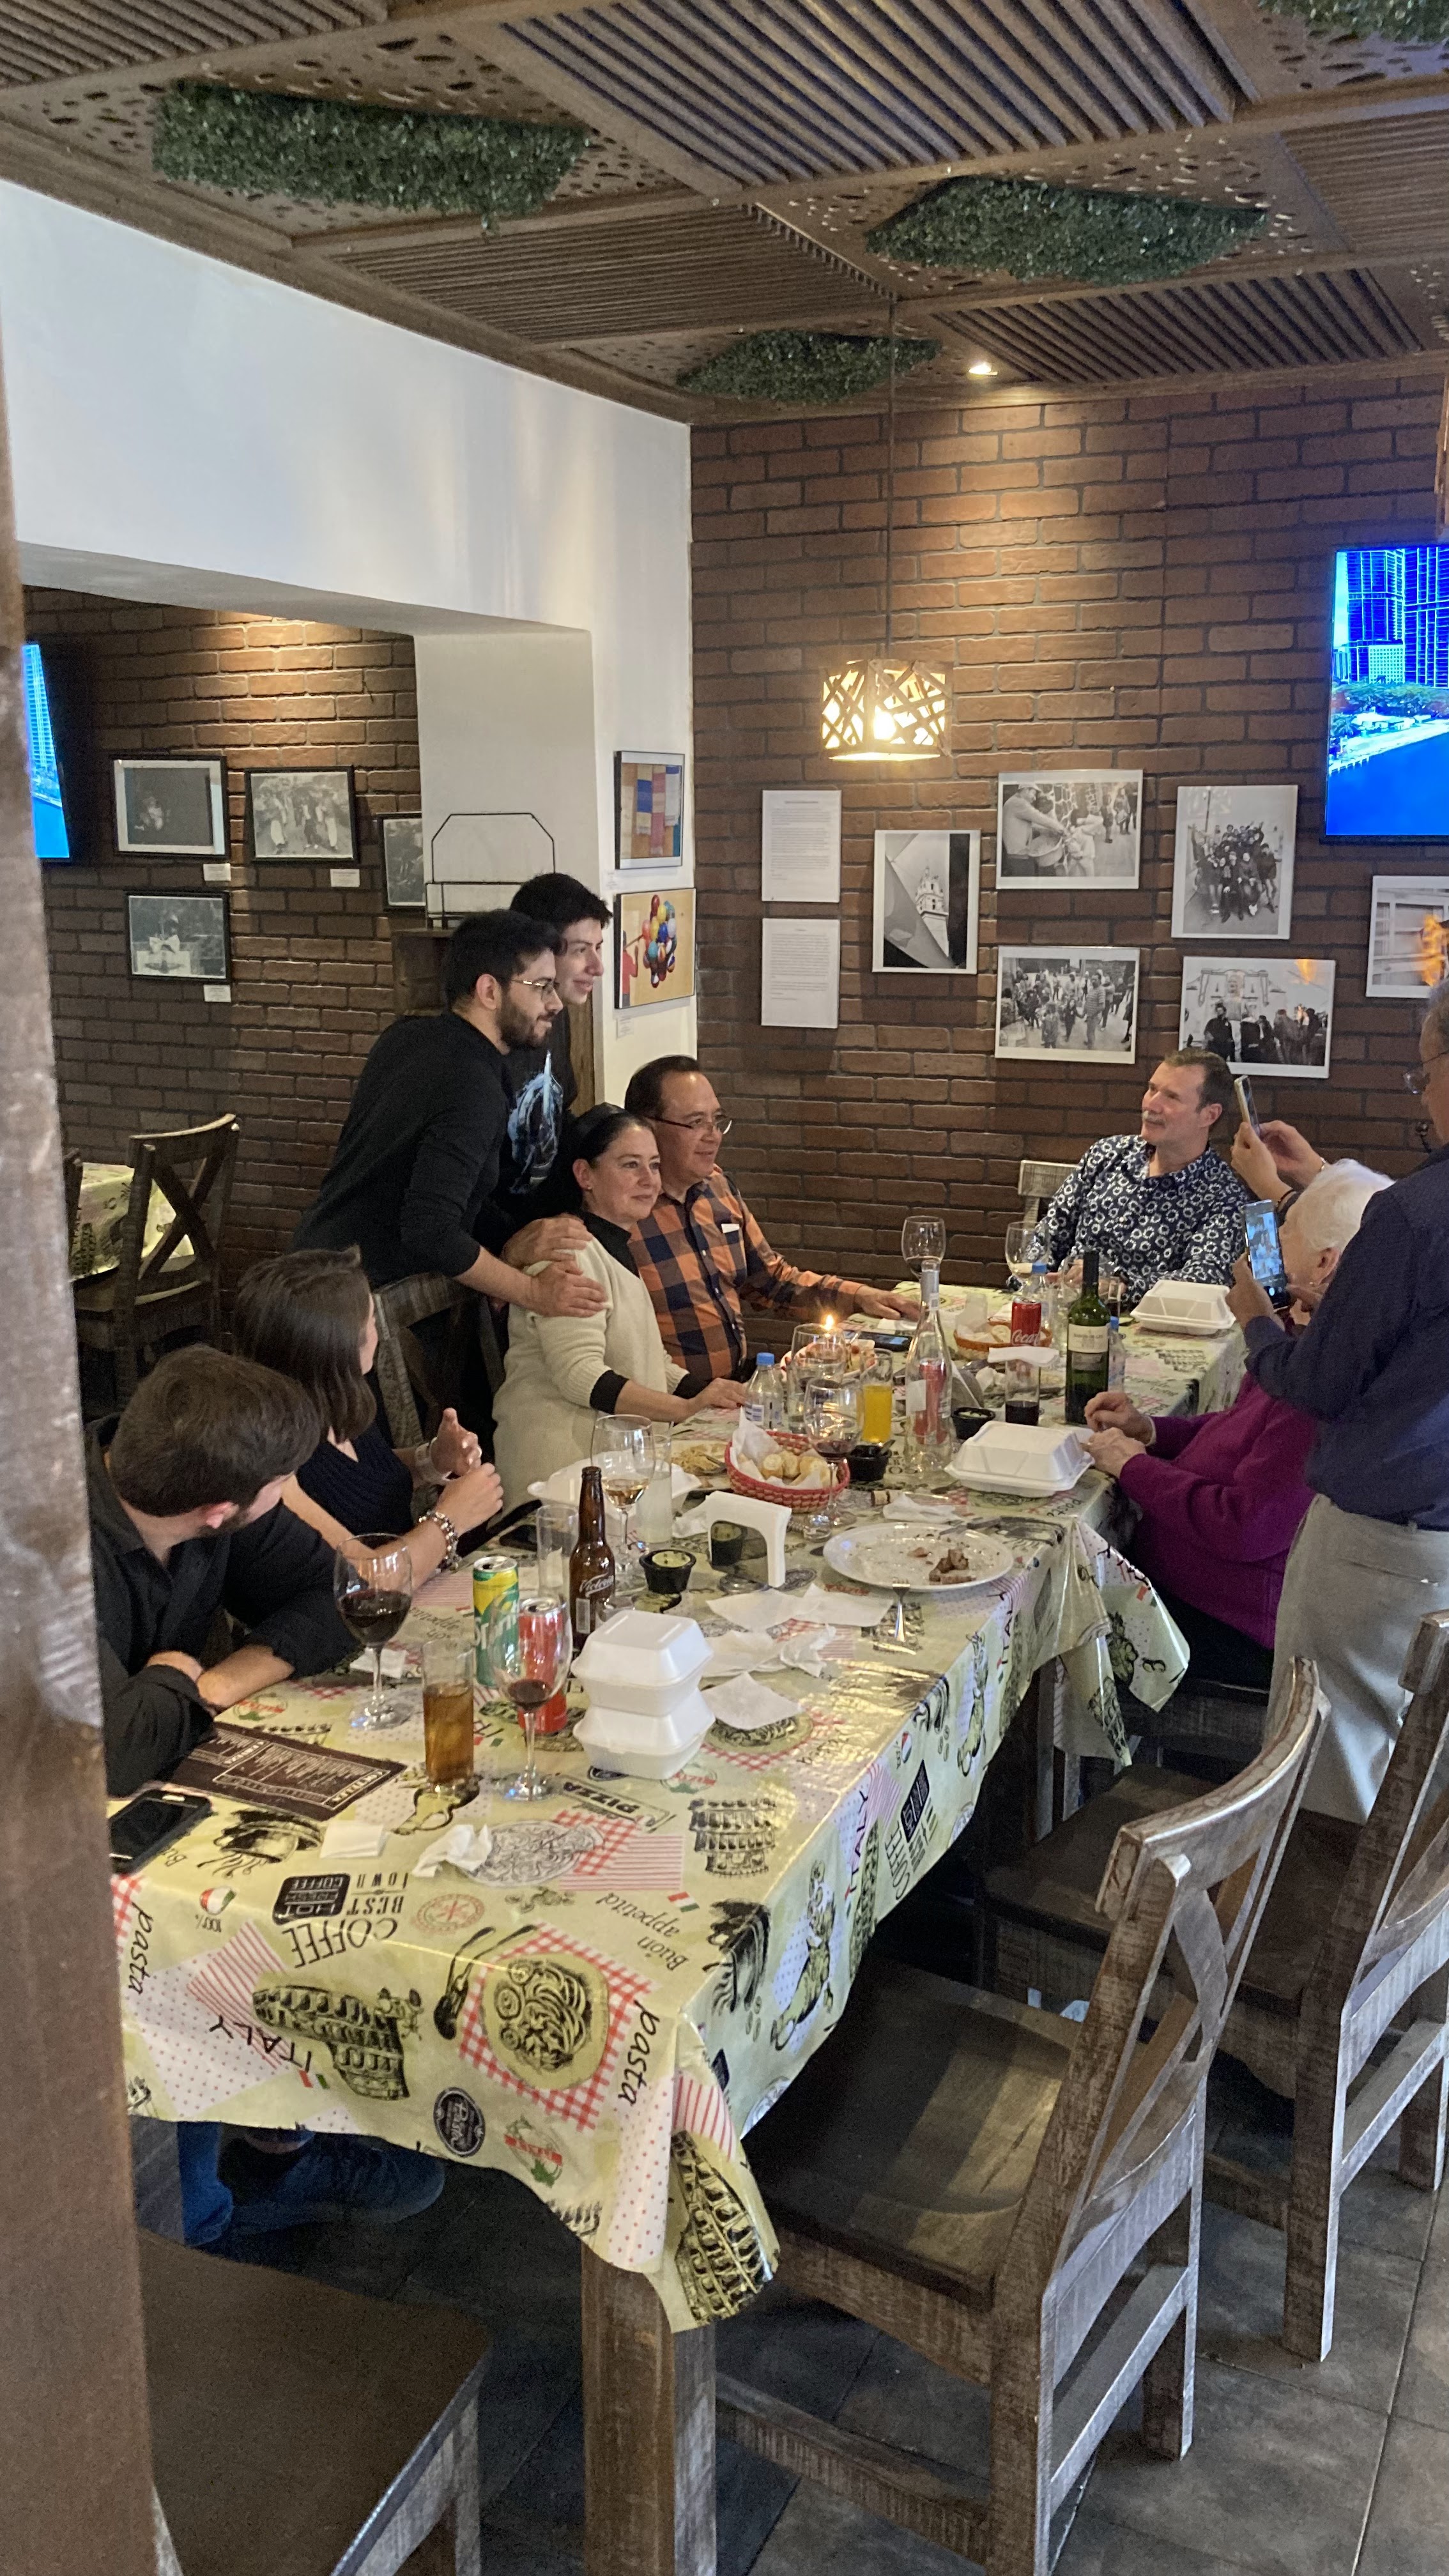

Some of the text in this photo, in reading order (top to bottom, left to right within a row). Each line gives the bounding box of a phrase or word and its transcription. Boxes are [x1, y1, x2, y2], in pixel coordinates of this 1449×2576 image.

[563, 1781, 641, 1814] PIZZA
[293, 1876, 344, 1889] COFFEE
[281, 1903, 335, 1918] HOT
[346, 1896, 404, 1916] BEST
[128, 1901, 154, 1995] pasta
[282, 1917, 398, 1968] COFFEE
[209, 2015, 312, 2073] ITALY
[618, 1999, 661, 2104] pasta
